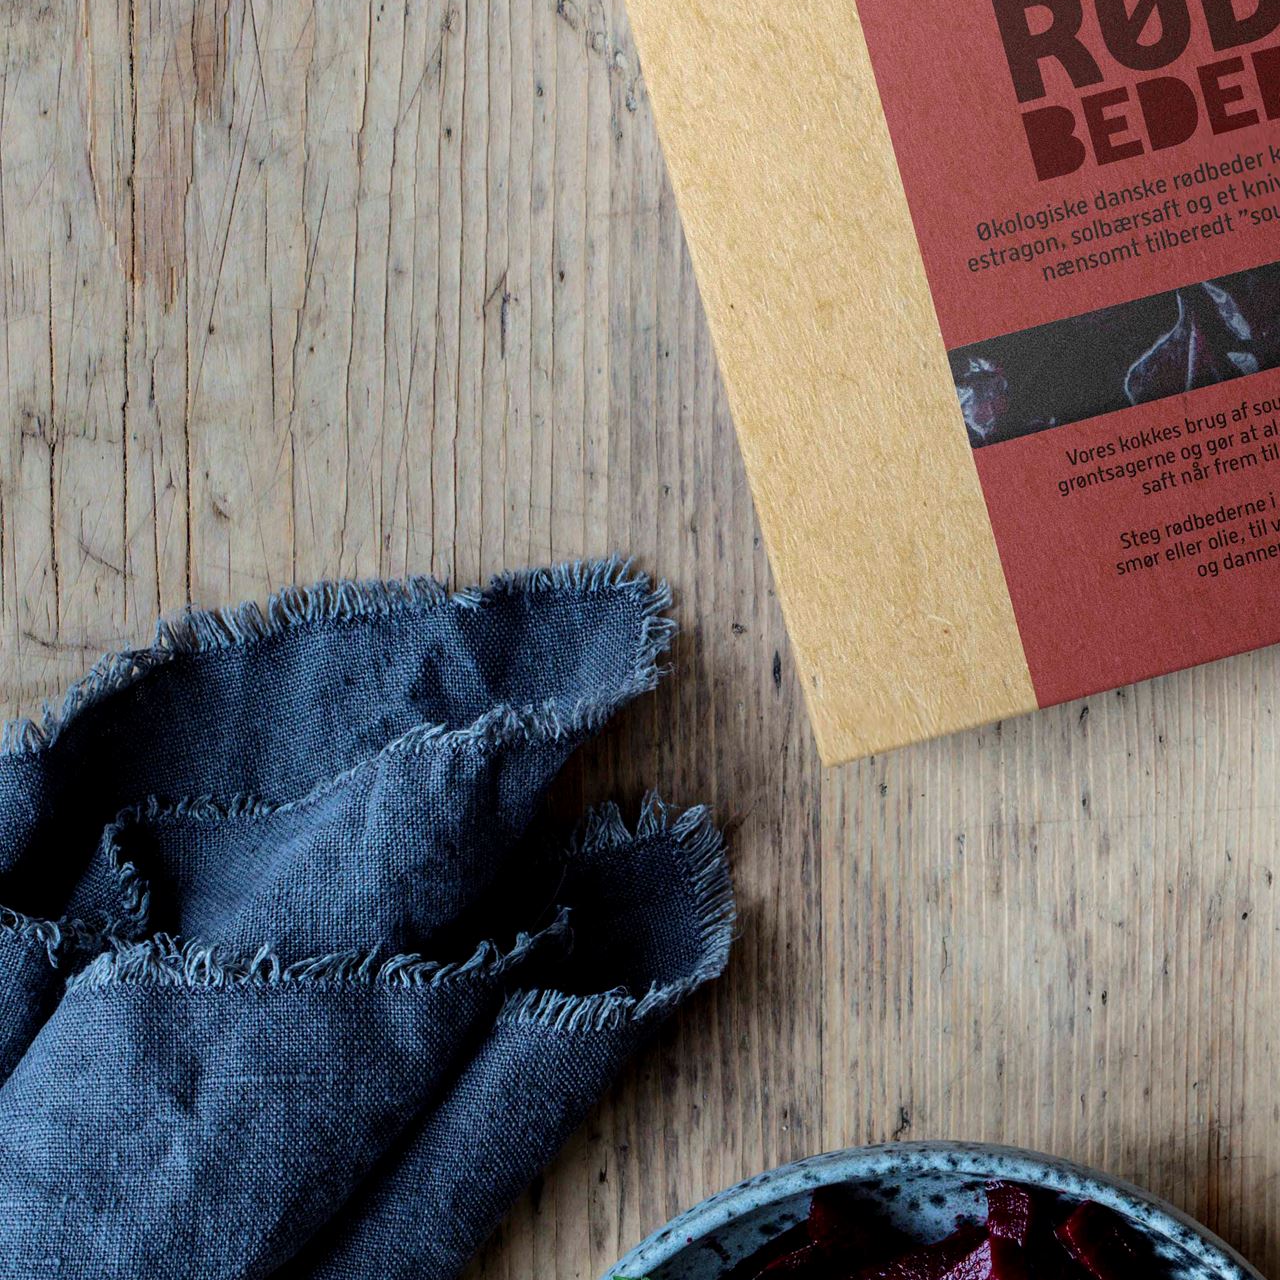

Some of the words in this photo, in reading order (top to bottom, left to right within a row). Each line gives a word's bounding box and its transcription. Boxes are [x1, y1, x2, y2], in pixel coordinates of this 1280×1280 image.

[967, 236, 1067, 273] estragon,
[1070, 198, 1182, 246] solbærsaft
[1186, 195, 1213, 215] og
[1216, 183, 1239, 206] et
[976, 199, 1089, 242] Økologiske
[1094, 178, 1167, 211] danske
[1172, 152, 1264, 191] rødbeder
[1042, 237, 1142, 282] nænsomt
[1144, 212, 1235, 254] tilberedt
[1057, 450, 1176, 497] grøntsagerne
[1180, 443, 1203, 461] og
[1206, 434, 1234, 456] gør
[1239, 424, 1259, 444] at
[1263, 418, 1279, 438] al
[1065, 442, 1116, 466] Vores
[1118, 425, 1182, 453] kokkes
[1184, 412, 1228, 434] brug
[1231, 400, 1248, 423] af
[1142, 471, 1177, 496] saft
[1180, 461, 1210, 485] når
[1213, 453, 1258, 476] frem
[1260, 442, 1280, 462] til
[1116, 551, 1160, 576] smør
[1164, 540, 1202, 562] eller
[1207, 528, 1246, 550] olie,
[1248, 518, 1268, 539] til
[1119, 528, 1162, 550] Steg
[1164, 499, 1266, 538] rødbederne
[1268, 491, 1276, 509] i
[1197, 560, 1219, 578] og
